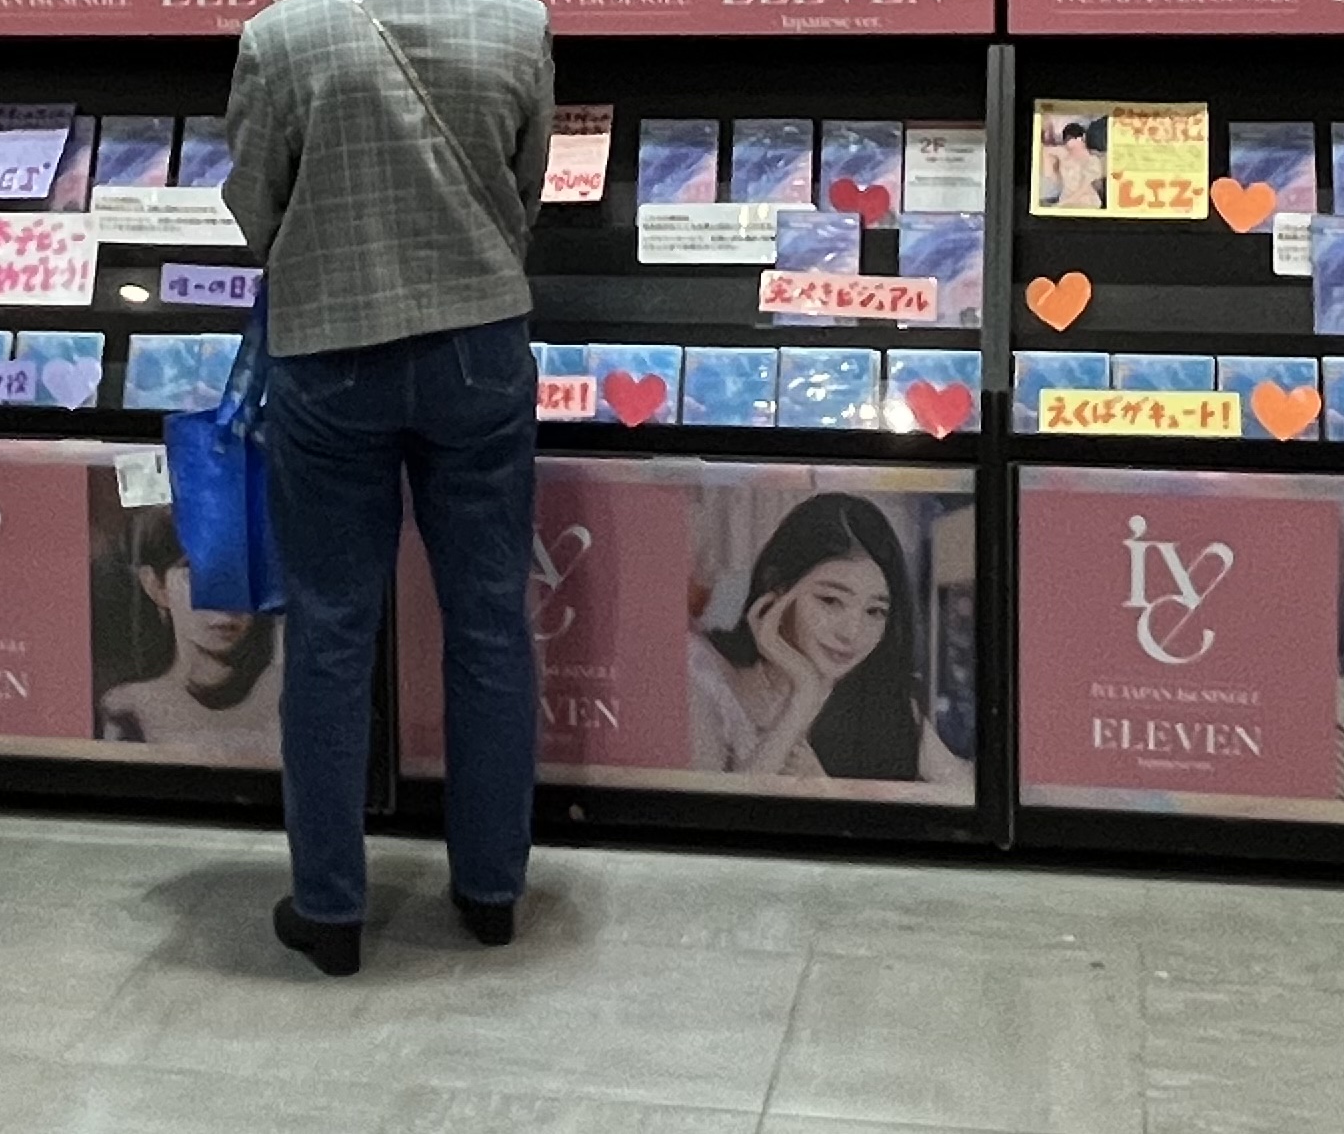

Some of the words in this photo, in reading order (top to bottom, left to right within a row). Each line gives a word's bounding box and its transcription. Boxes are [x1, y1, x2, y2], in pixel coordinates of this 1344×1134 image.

[1118, 179, 1194, 208] LIZ
[540, 696, 620, 728] VEN
[1092, 718, 1262, 756] ELEVEN
